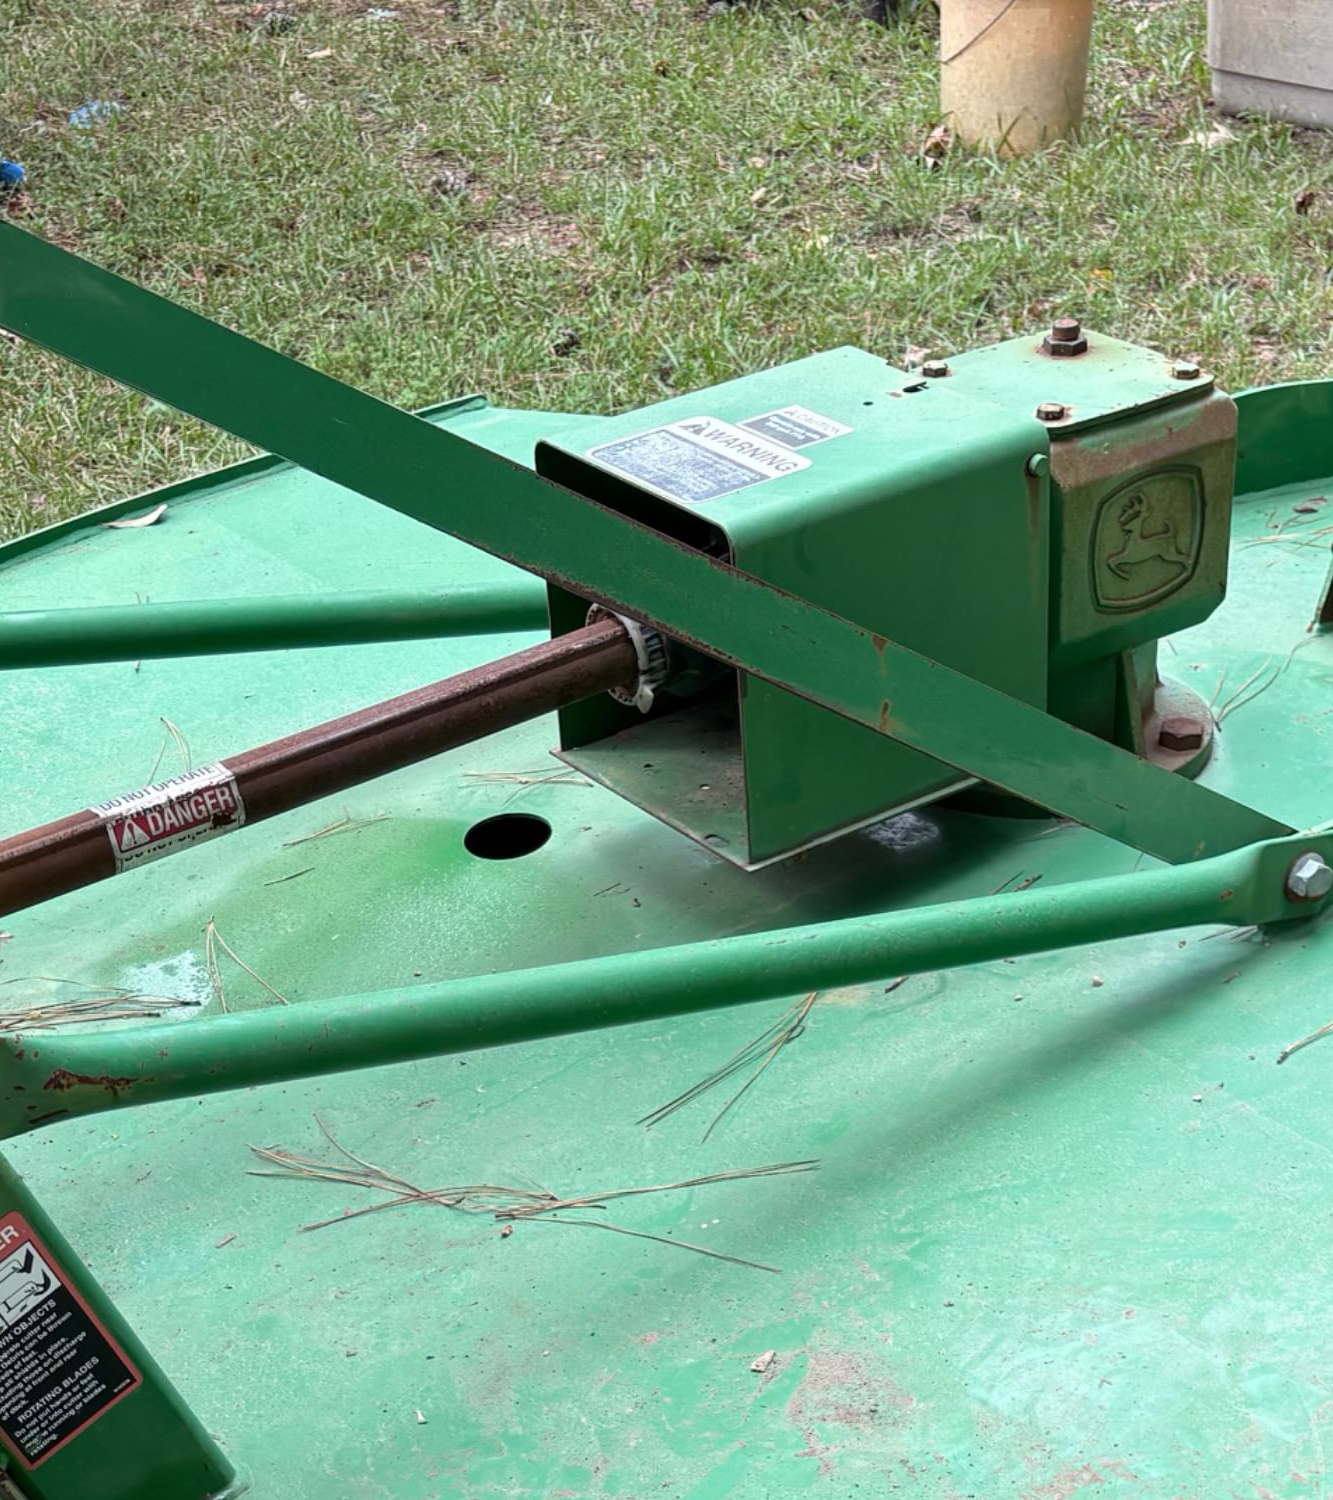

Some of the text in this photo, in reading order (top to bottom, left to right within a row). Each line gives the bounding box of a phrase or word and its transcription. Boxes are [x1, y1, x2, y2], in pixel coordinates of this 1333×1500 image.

[704, 429, 798, 472] WARNING
[147, 786, 235, 836] DANGER
[13, 1299, 56, 1335] OBJECTS
[20, 1325, 40, 1343] cutter
[41, 1312, 56, 1326] near
[0, 1350, 24, 1369] Debris
[24, 1339, 38, 1350] can
[37, 1331, 47, 1339] be
[47, 1312, 71, 1331] thrown
[22, 1366, 43, 1383] those
[43, 1358, 53, 1367] on
[53, 1331, 86, 1359] discharge
[4, 1378, 14, 1387] all
[14, 1359, 39, 1380] shields
[38, 1352, 47, 1360] in
[14, 1361, 21, 1369] of
[25, 1384, 32, 1392] at
[32, 1370, 49, 1385] front
[49, 1359, 63, 1372] and
[63, 1349, 76, 1361] rear
[14, 1373, 94, 1437] Do not put hands or feet
[17, 1356, 99, 1423] ROTATING BLADES
[20, 1426, 39, 1443] under
[40, 1419, 48, 1427] or
[48, 1408, 63, 1420] into
[63, 1392, 82, 1409] cutter
[83, 1380, 98, 1393] with
[48, 1408, 75, 1431] running
[82, 1384, 106, 1403] blades
[2, 1412, 9, 1420] of
